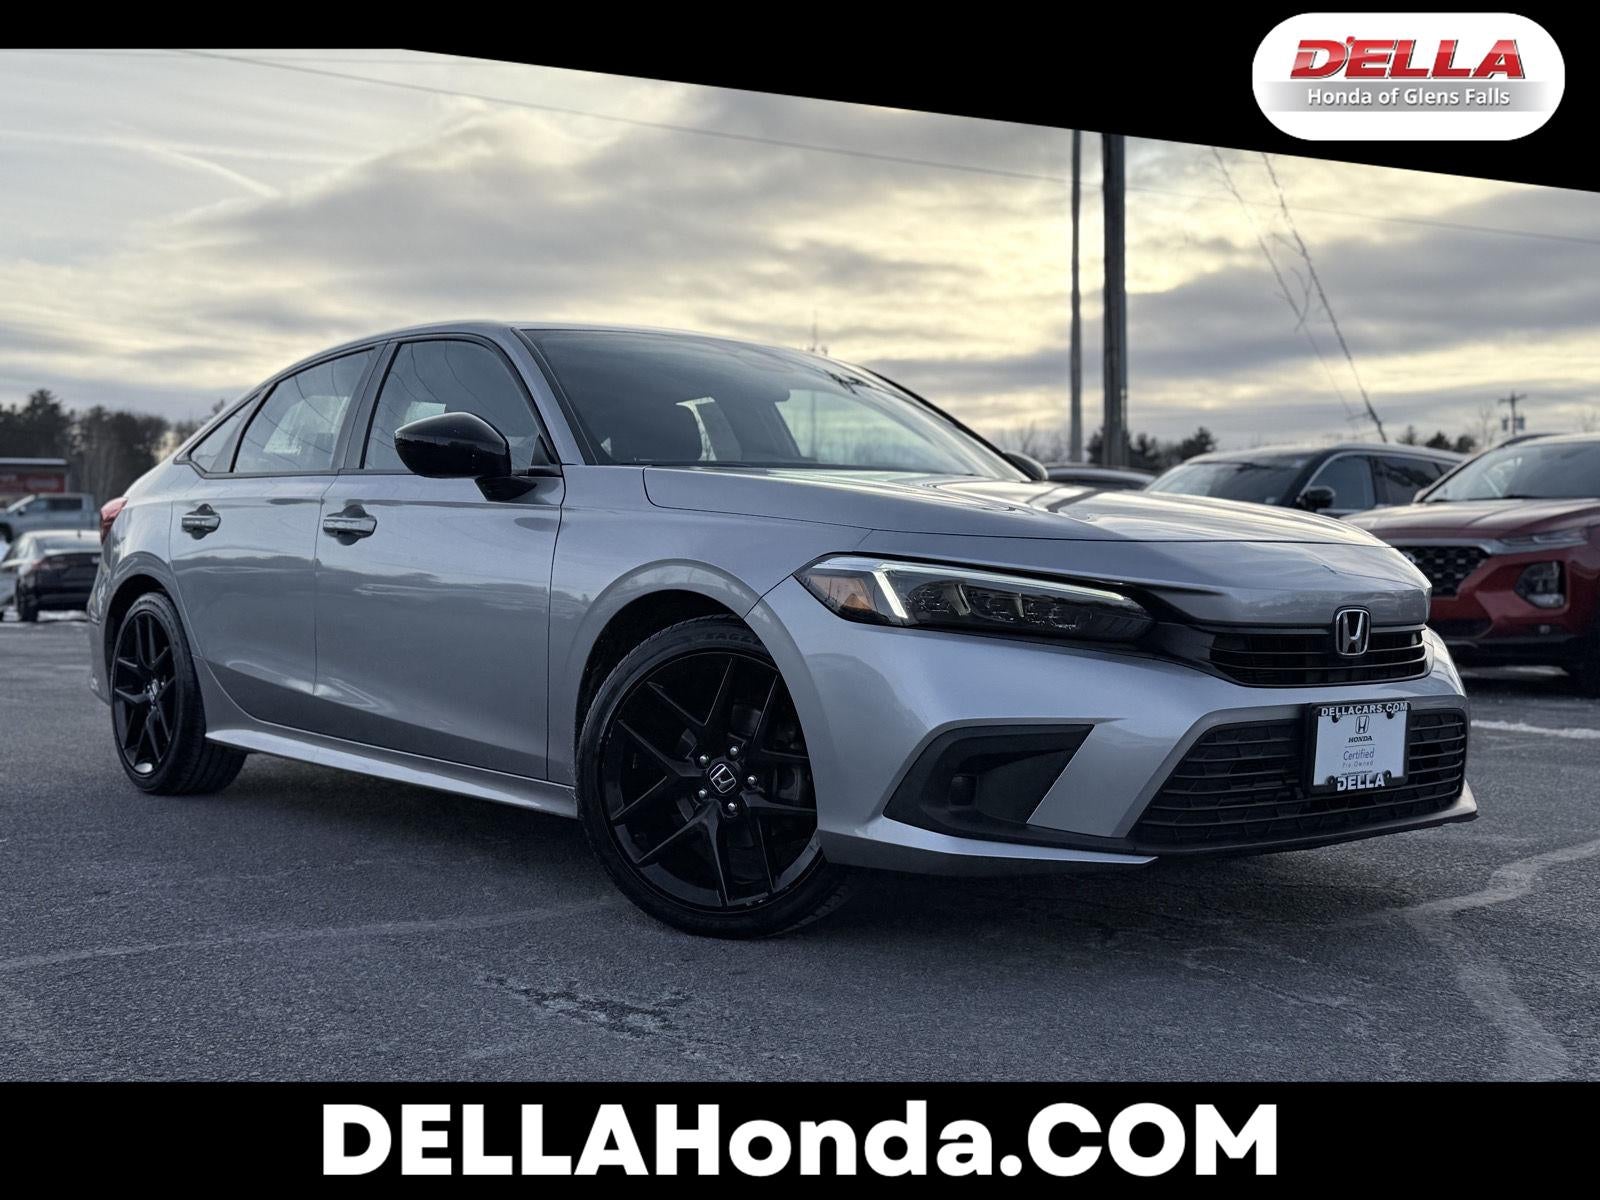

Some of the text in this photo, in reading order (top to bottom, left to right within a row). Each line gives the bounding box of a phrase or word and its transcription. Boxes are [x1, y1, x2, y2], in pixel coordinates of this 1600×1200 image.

[1321, 702, 1407, 716] DELLACARS.COM
[1348, 735, 1373, 743] HONDA
[1343, 748, 1375, 760] Certified
[1337, 772, 1386, 792] DELLA
